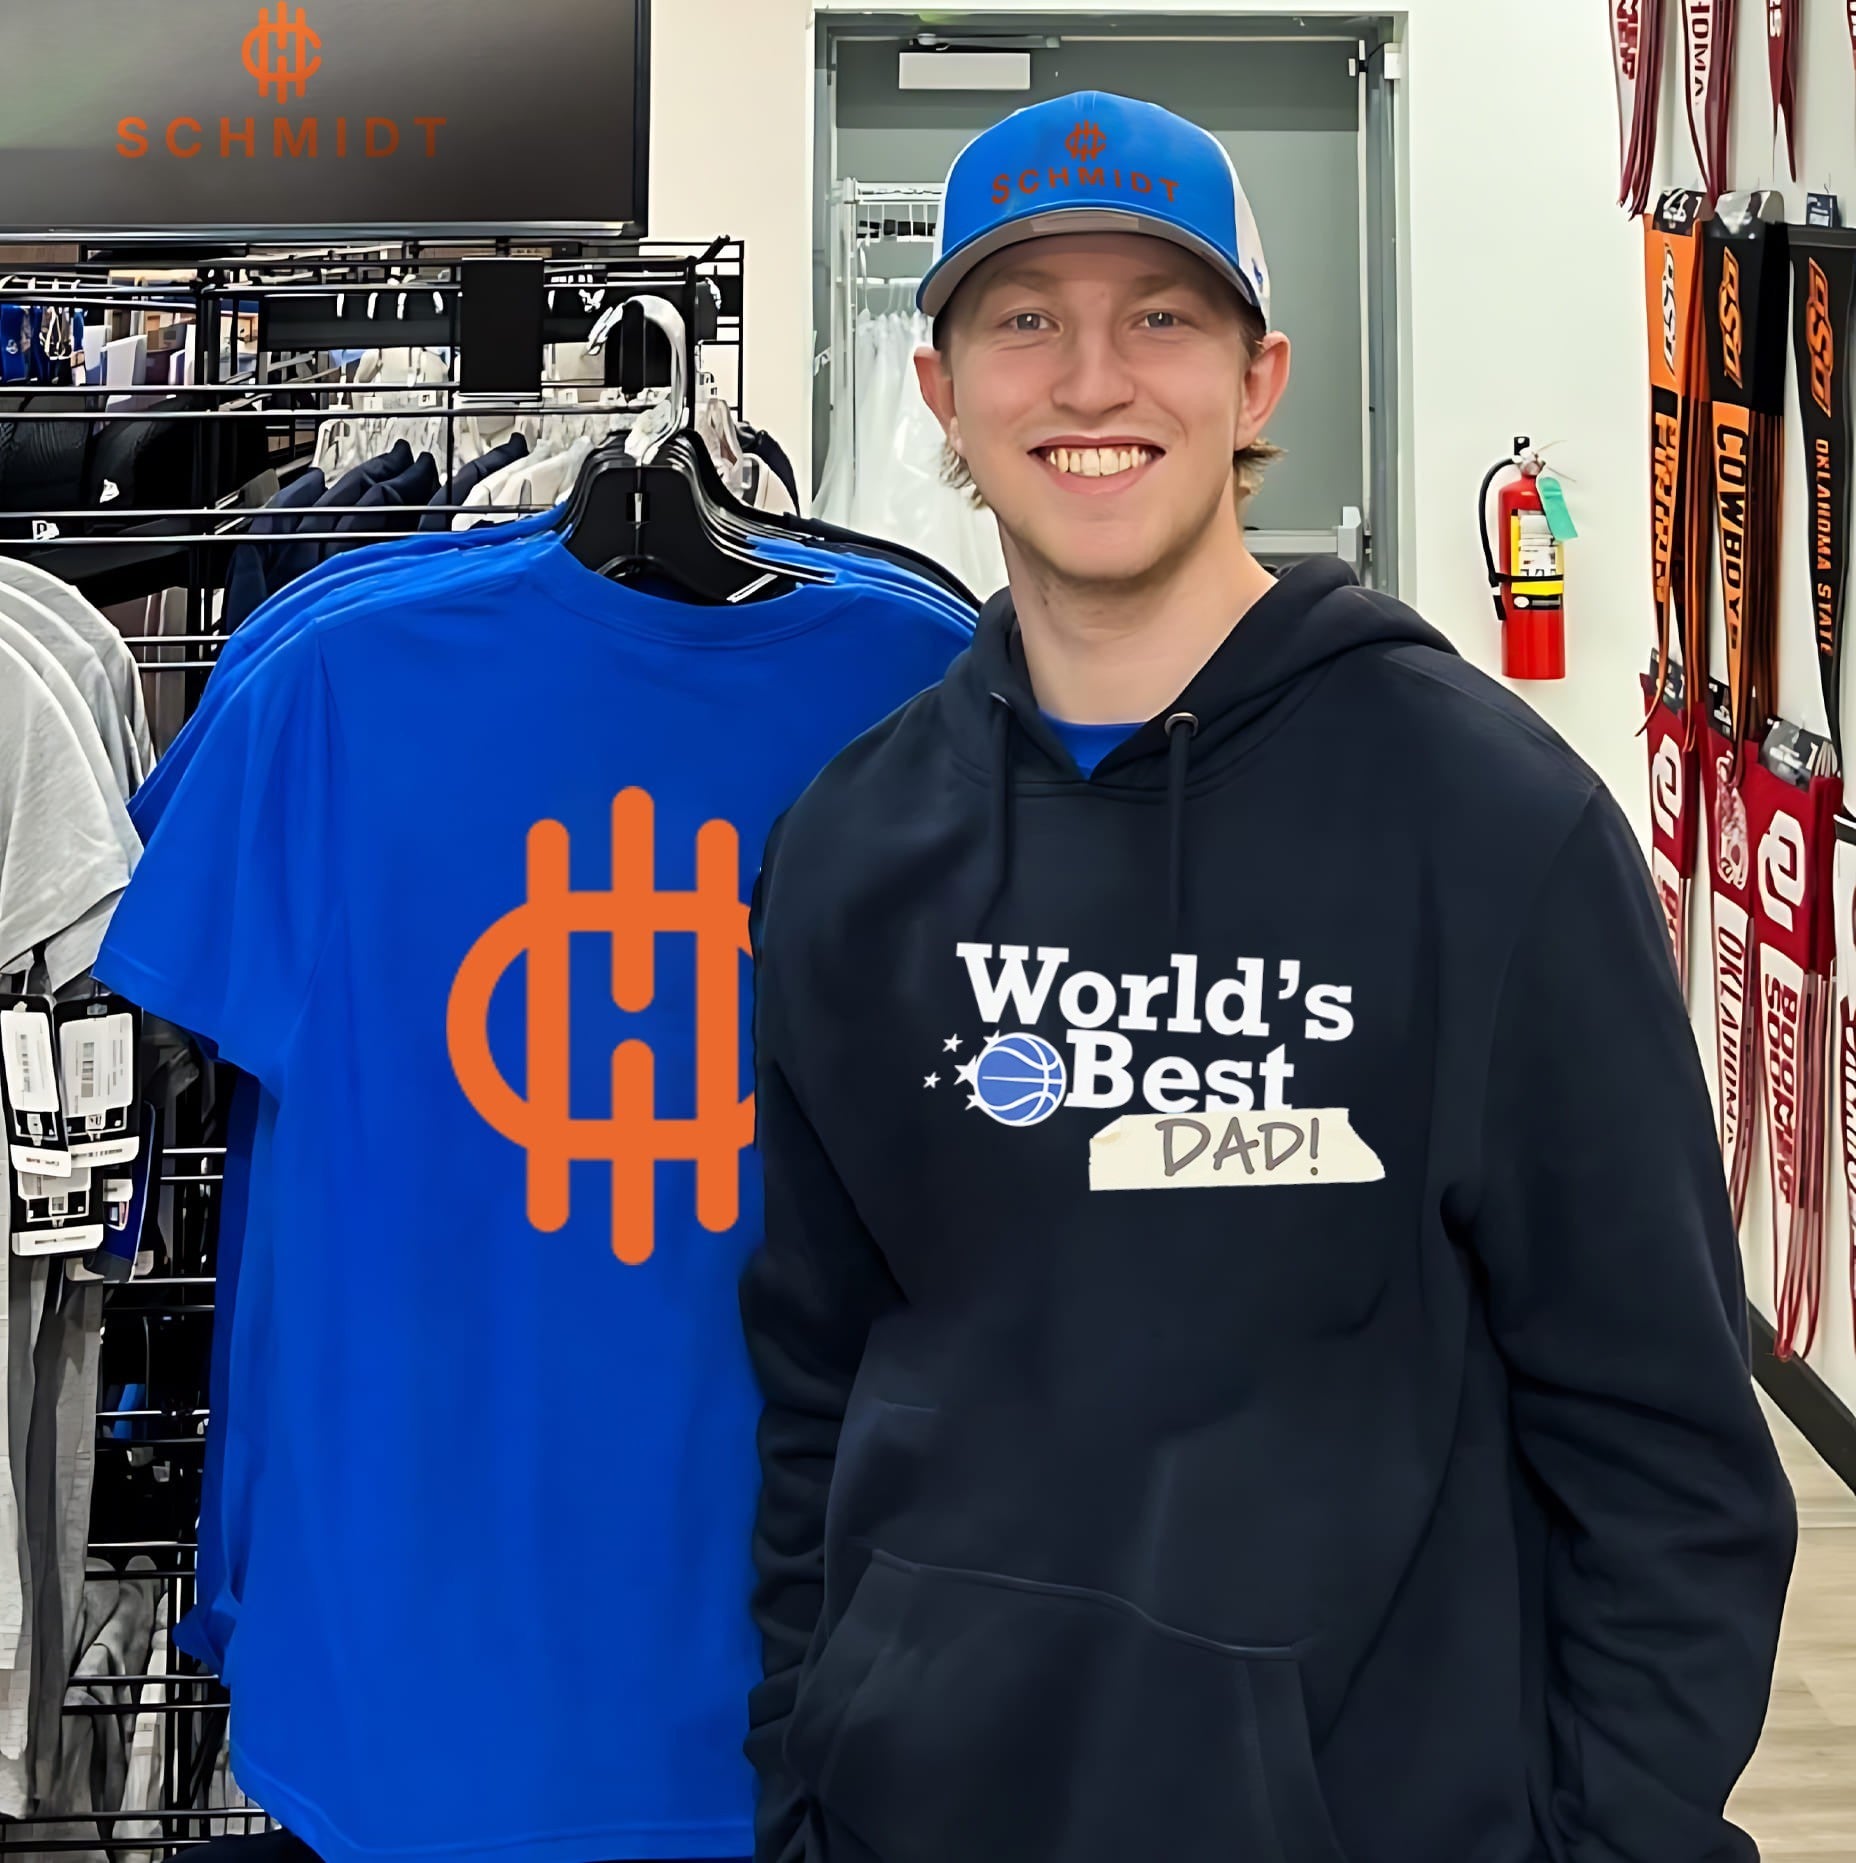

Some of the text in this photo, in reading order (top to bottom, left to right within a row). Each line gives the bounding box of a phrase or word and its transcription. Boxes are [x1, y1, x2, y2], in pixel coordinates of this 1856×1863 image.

[116, 117, 448, 159] SCHMIDT
[991, 166, 1179, 205] SCHMIDT
[956, 942, 1355, 1042] World's
[1717, 925, 1744, 1144] OKLAHOMA
[1063, 1029, 1295, 1114] Best
[1154, 1116, 1320, 1177] DAD!
